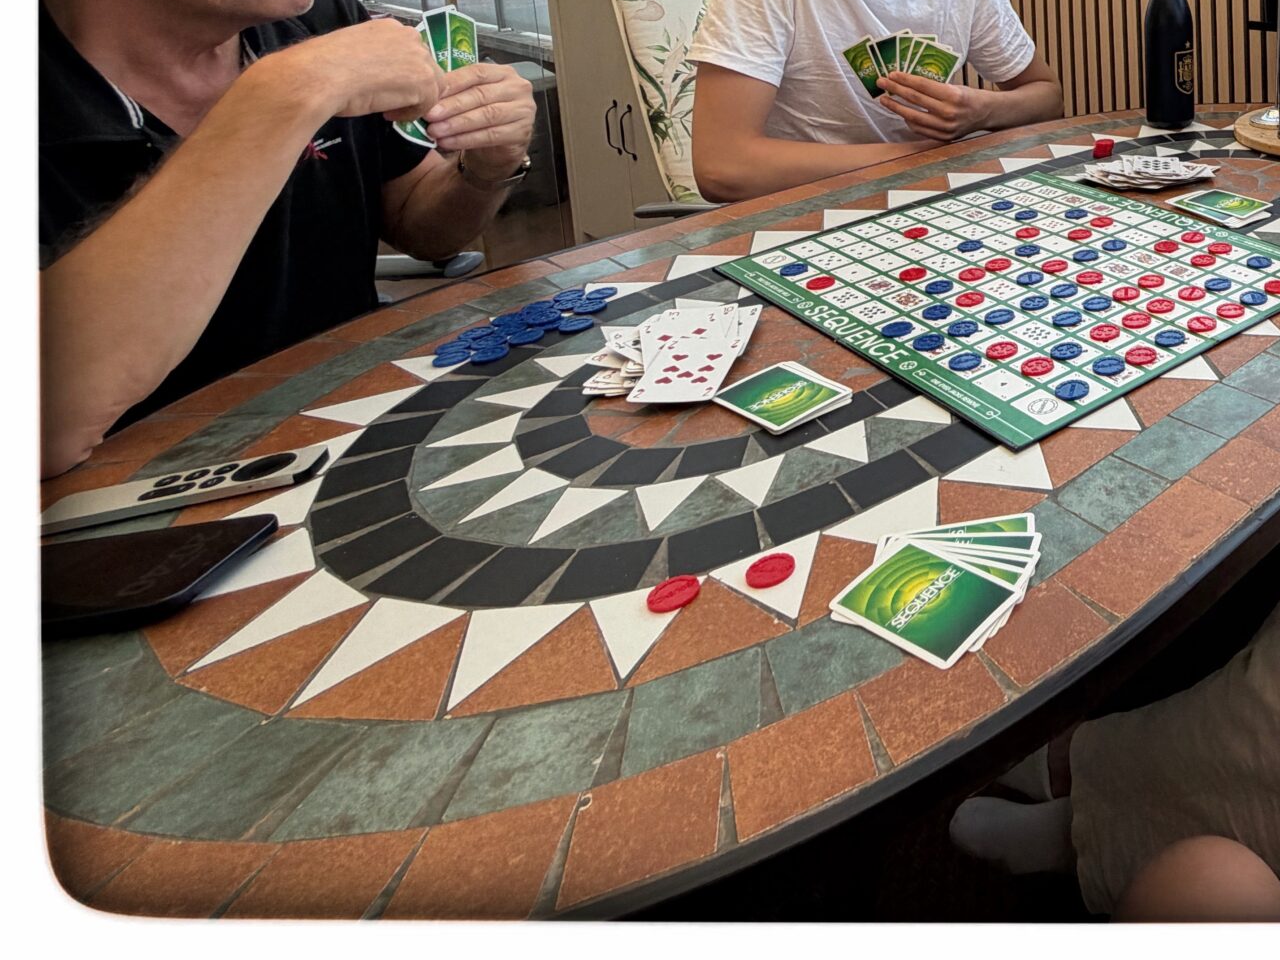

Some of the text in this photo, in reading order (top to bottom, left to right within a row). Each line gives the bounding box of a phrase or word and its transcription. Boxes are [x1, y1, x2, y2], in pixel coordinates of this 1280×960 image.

[1116, 199, 1219, 234] SEQUENCE
[804, 305, 911, 364] SEQUENCE
[890, 567, 961, 628] SEQUENCE
